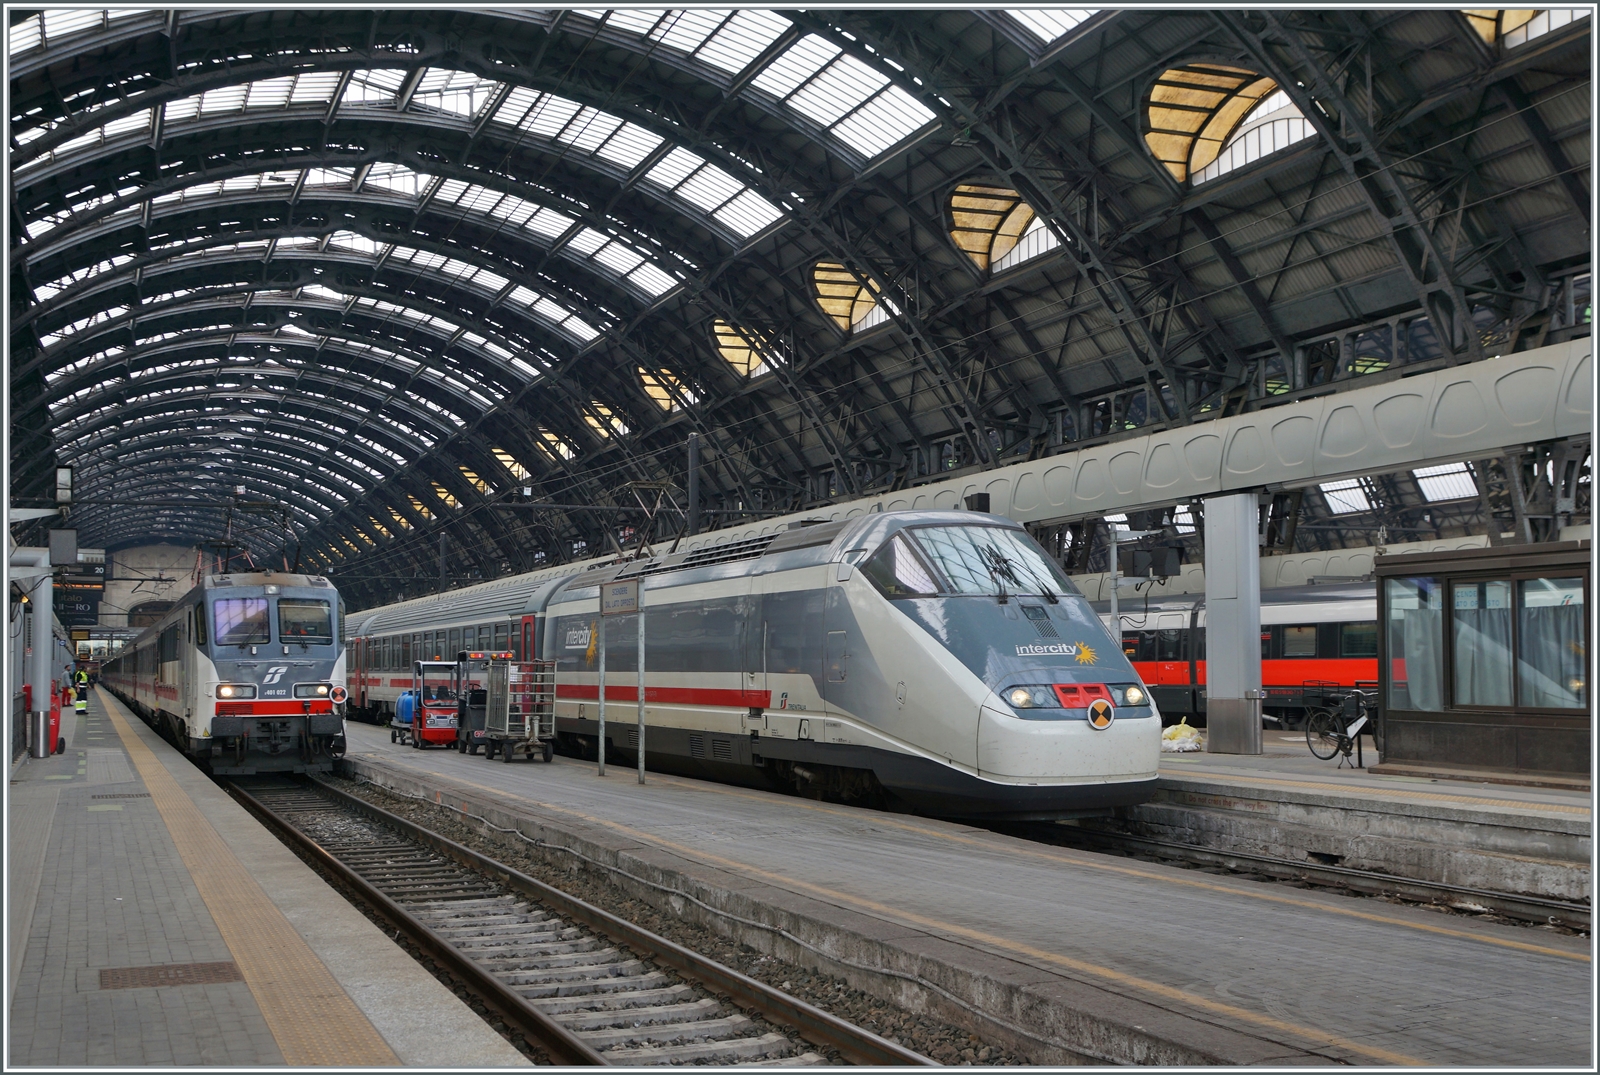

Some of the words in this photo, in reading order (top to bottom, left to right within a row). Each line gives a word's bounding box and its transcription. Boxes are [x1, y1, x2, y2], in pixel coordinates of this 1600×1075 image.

[612, 586, 628, 596] SCENDERE
[565, 626, 592, 648] intercity
[1015, 643, 1076, 656] intercity
